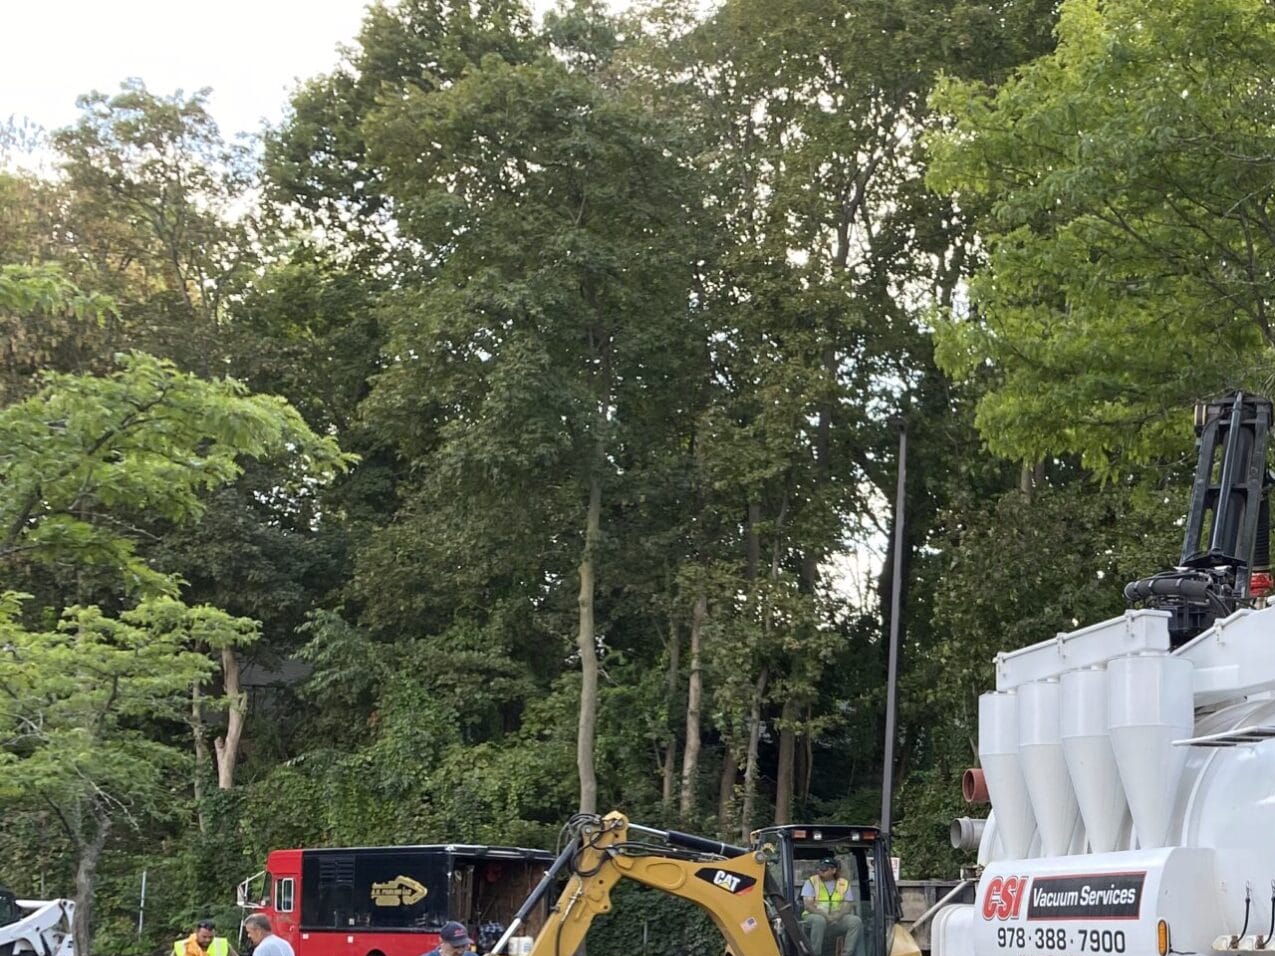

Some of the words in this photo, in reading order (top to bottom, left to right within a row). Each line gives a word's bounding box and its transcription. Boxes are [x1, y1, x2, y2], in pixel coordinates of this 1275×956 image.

[713, 870, 741, 892] CAT
[982, 875, 1029, 921] CSI
[1033, 887, 1080, 908] Vacuum
[1079, 884, 1136, 906] Services
